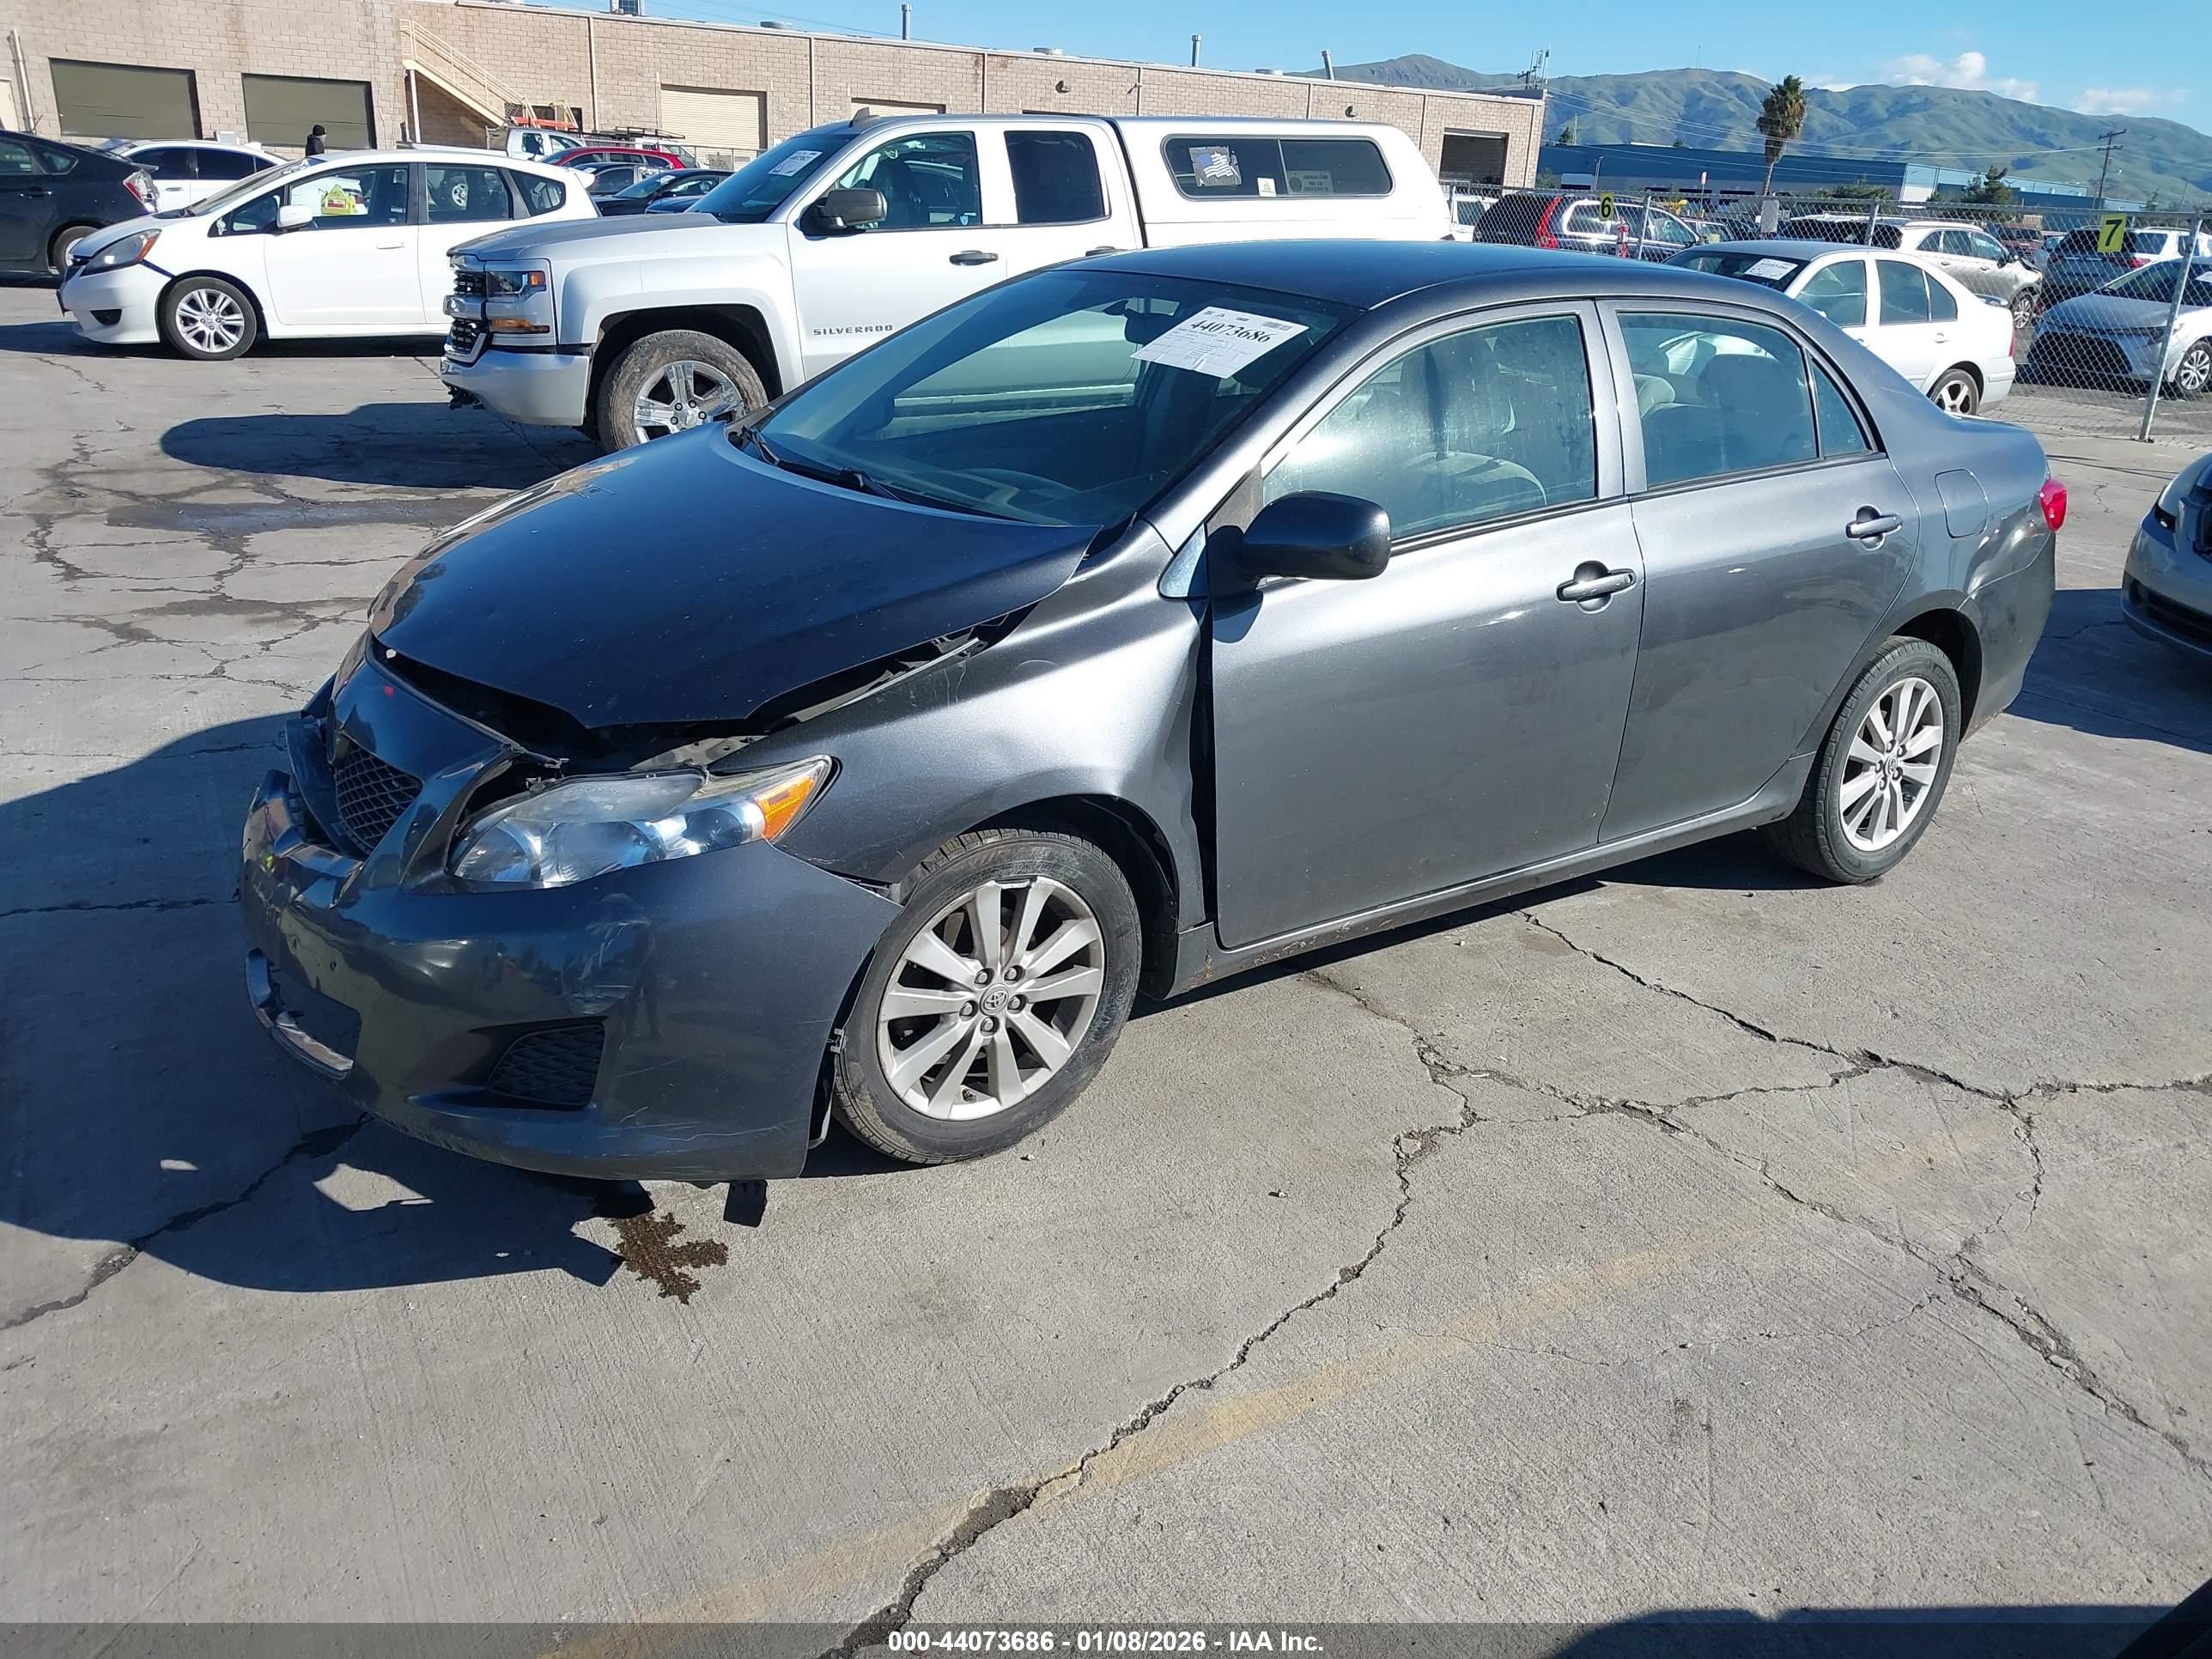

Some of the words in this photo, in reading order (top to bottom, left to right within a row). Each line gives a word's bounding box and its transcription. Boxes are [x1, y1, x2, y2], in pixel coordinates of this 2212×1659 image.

[1601, 196, 1612, 218] 6
[2105, 218, 2124, 247] 7
[812, 325, 894, 336] SILVERADO
[1191, 319, 1277, 343] 44073686
